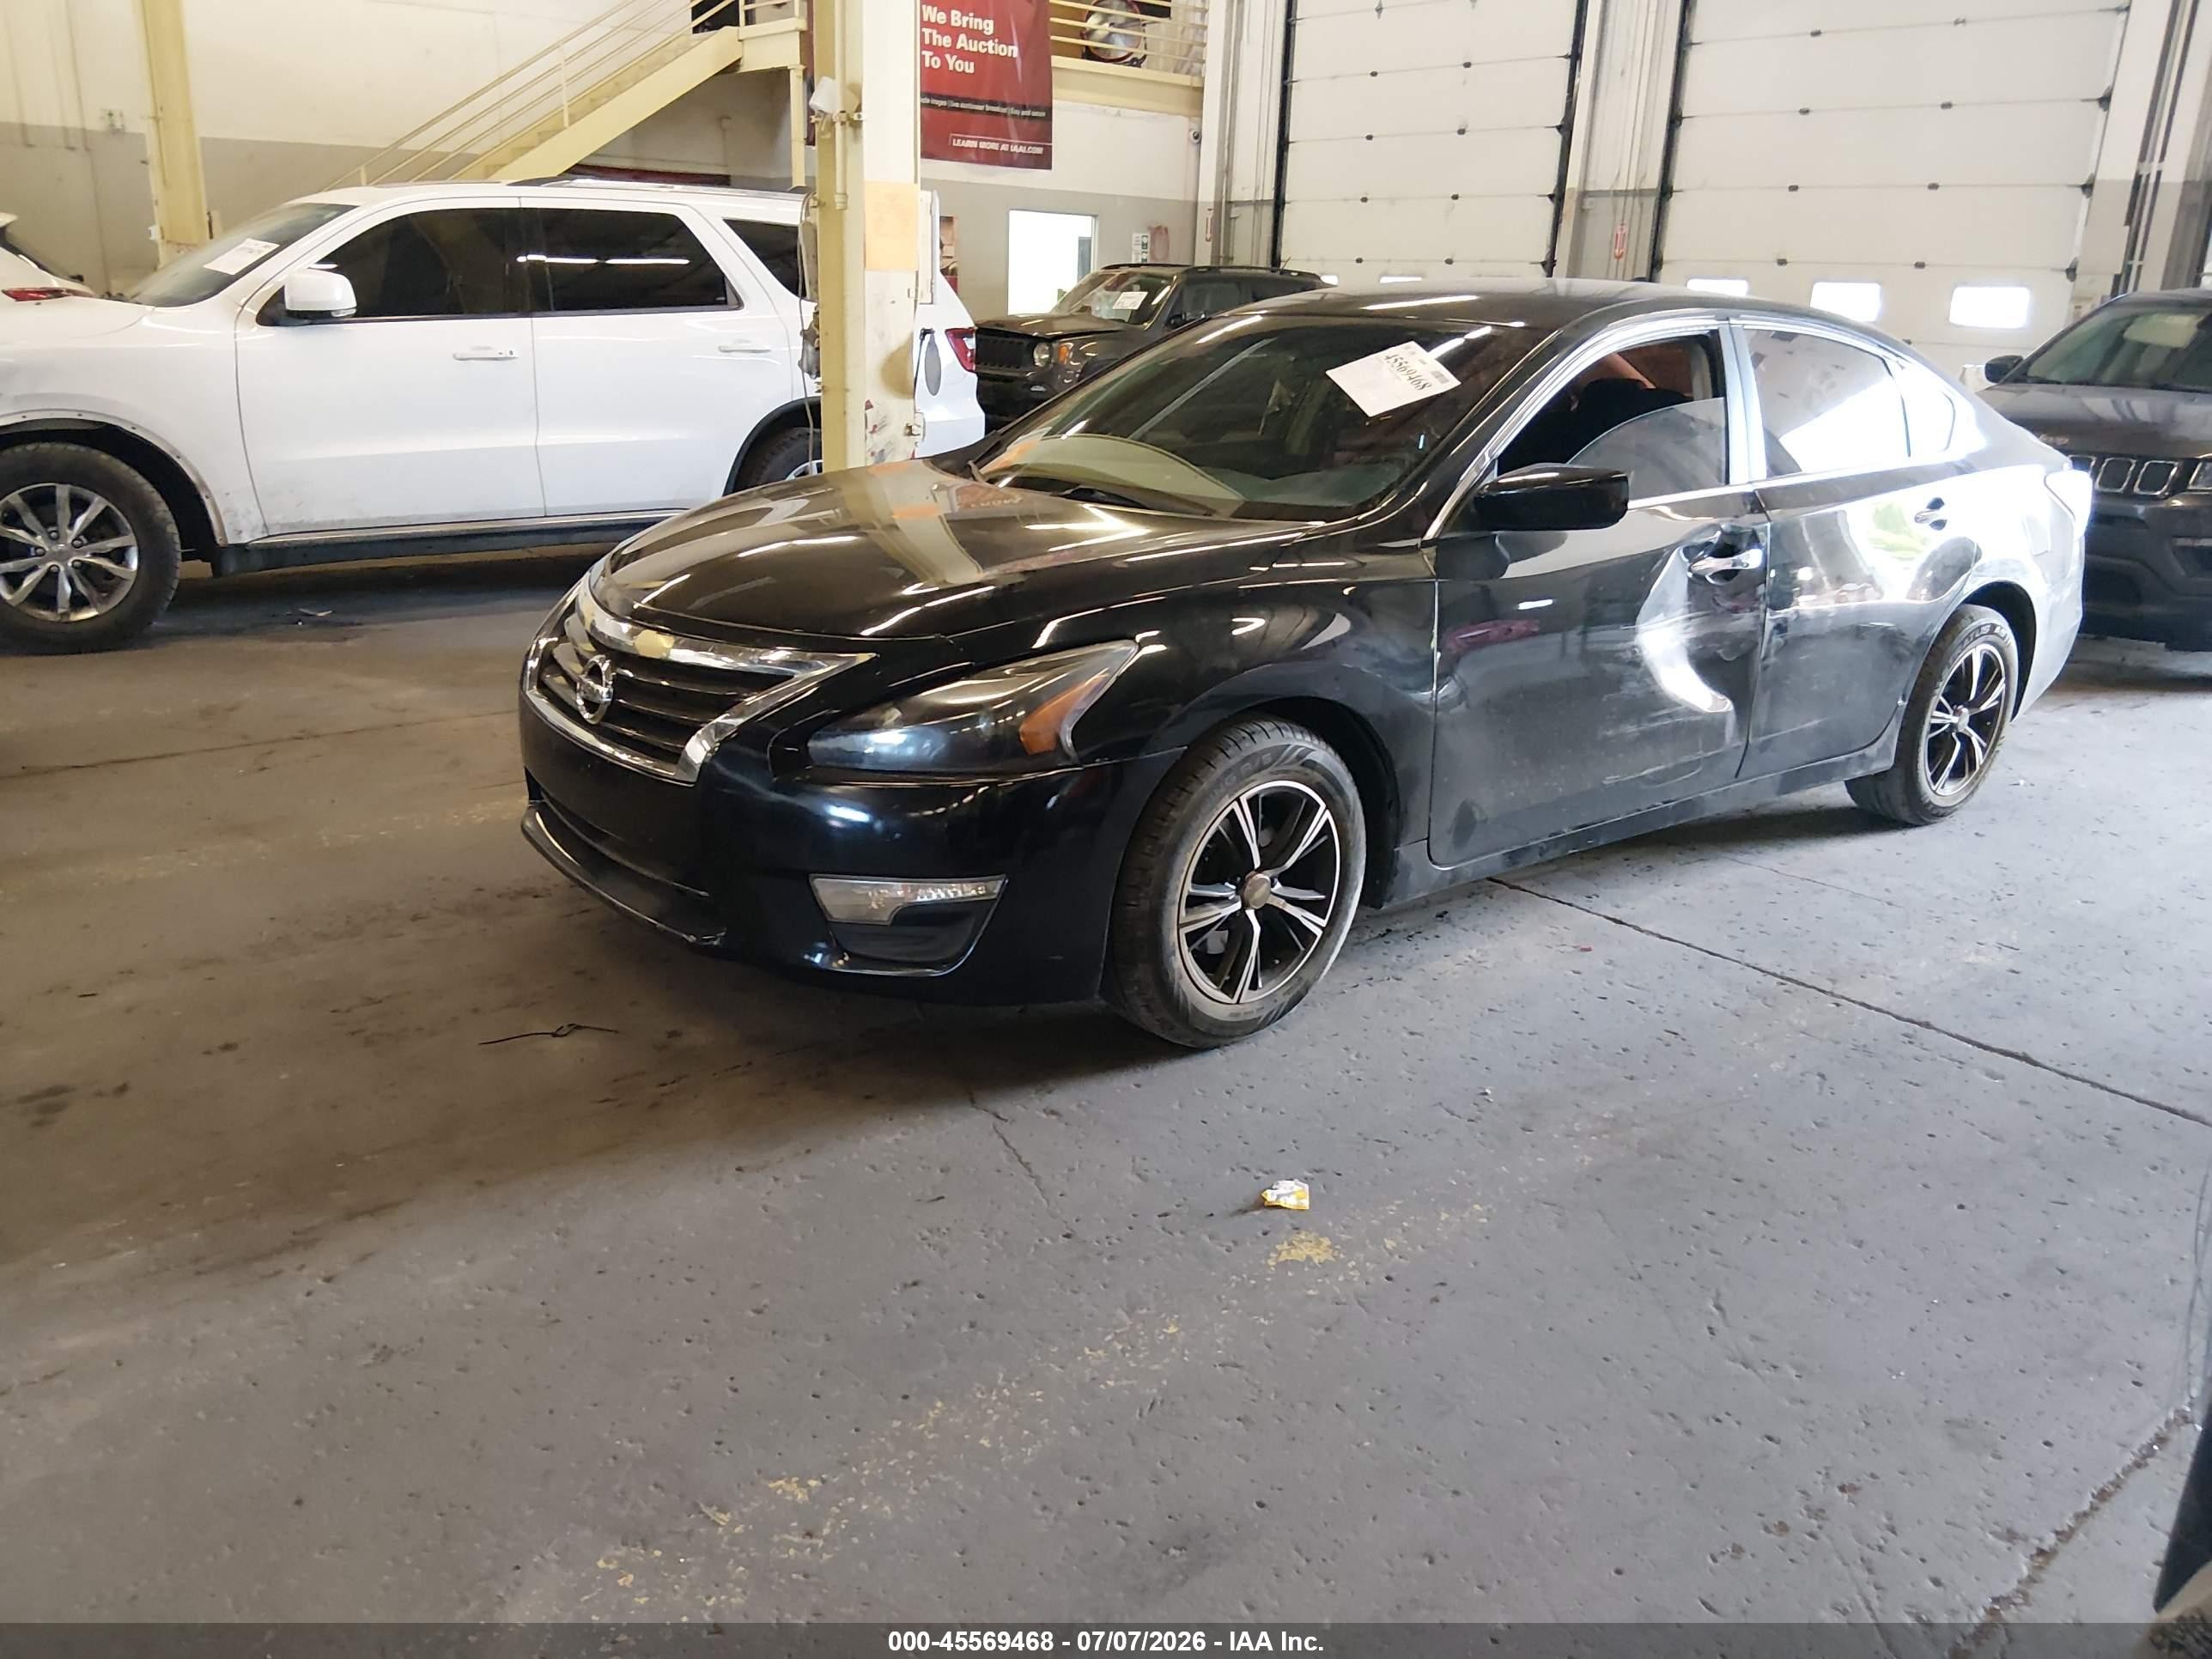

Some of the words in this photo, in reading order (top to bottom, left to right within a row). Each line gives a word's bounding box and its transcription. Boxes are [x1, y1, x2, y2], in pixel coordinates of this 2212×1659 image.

[921, 4, 947, 24] We
[951, 9, 994, 35] Bring
[921, 27, 952, 47] The
[956, 33, 1018, 58] Auction
[921, 50, 941, 69] To
[945, 53, 975, 73] You
[952, 138, 977, 148] LEARN
[979, 141, 999, 150] MORE
[1383, 353, 1432, 391] 45569468
